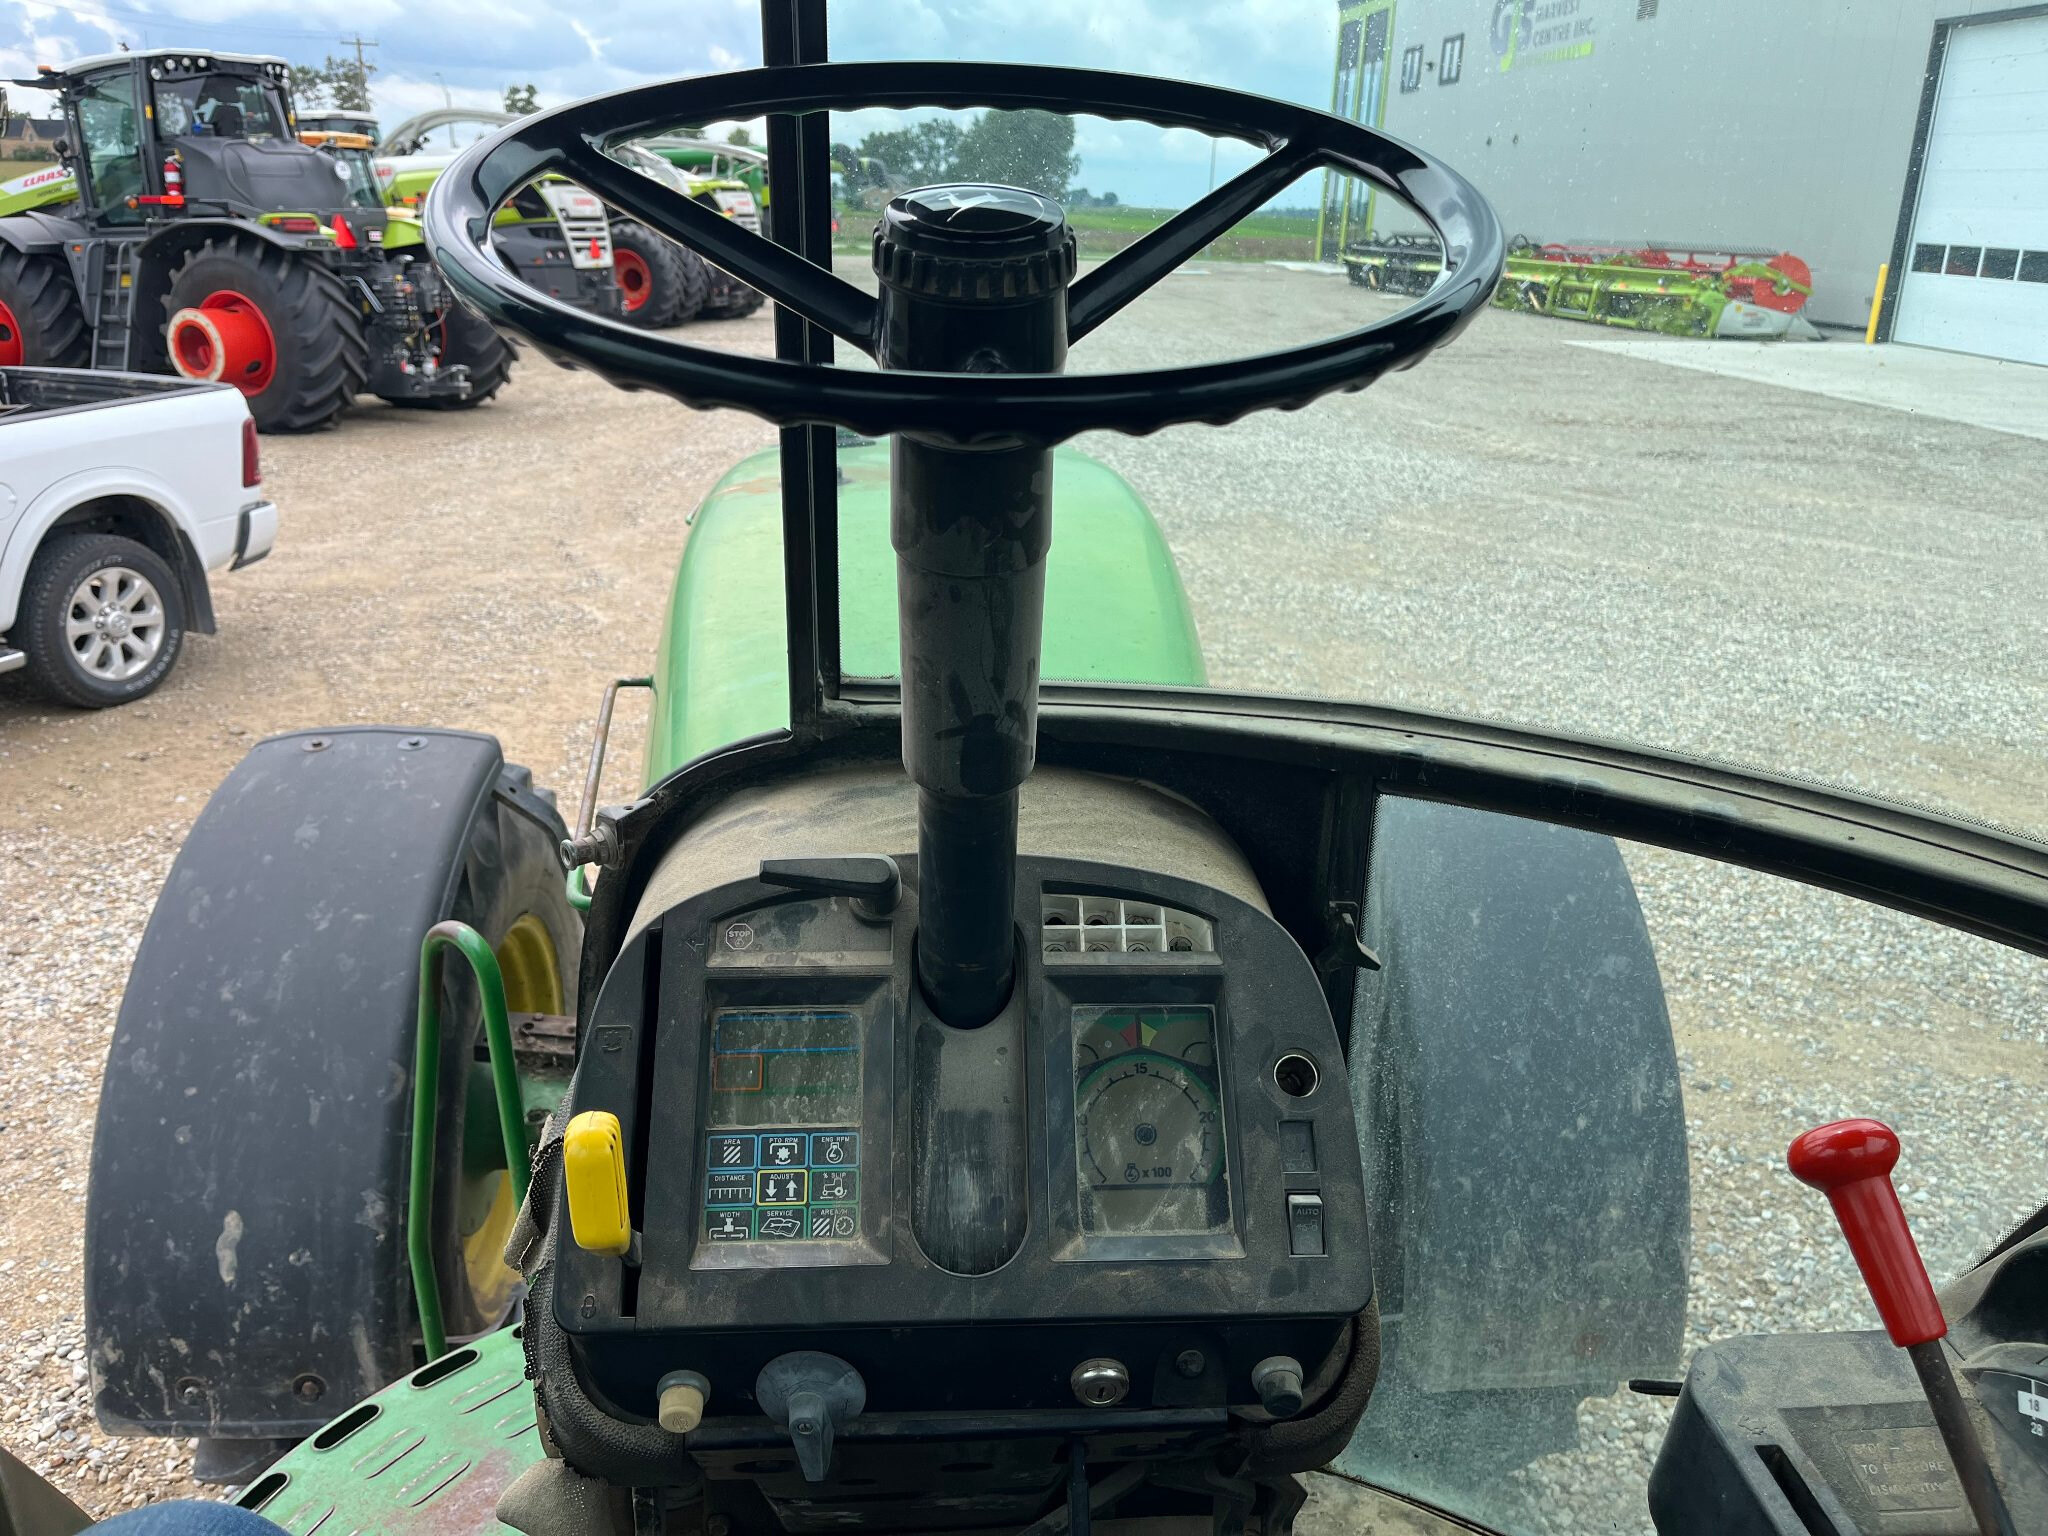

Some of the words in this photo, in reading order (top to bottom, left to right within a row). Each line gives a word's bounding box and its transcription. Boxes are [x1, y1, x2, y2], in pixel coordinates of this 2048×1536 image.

[1133, 1062, 1148, 1074] 15
[1200, 1111, 1216, 1123] 20
[1152, 1167, 1172, 1177] 100
[766, 1209, 794, 1217] SERVICE
[2028, 1399, 2040, 1412] 18
[2030, 1421, 2044, 1437] 28
[1861, 1463, 1878, 1475] TO
